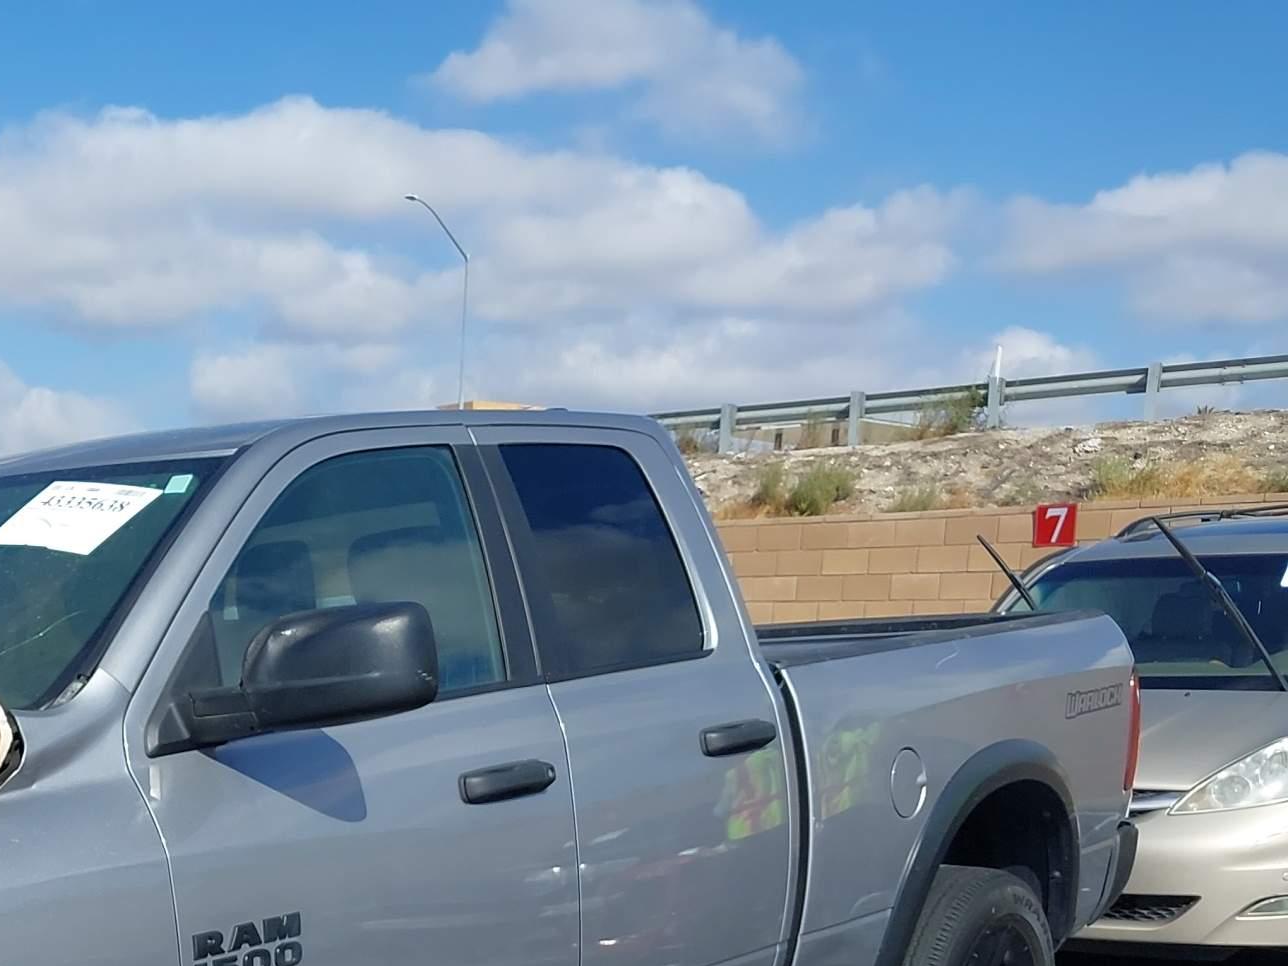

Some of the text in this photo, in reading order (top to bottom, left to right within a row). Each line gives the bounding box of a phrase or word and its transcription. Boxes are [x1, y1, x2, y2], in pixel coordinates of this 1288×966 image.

[40, 495, 131, 512] 43335638
[1045, 507, 1069, 543] 7
[191, 911, 302, 961] RAM
